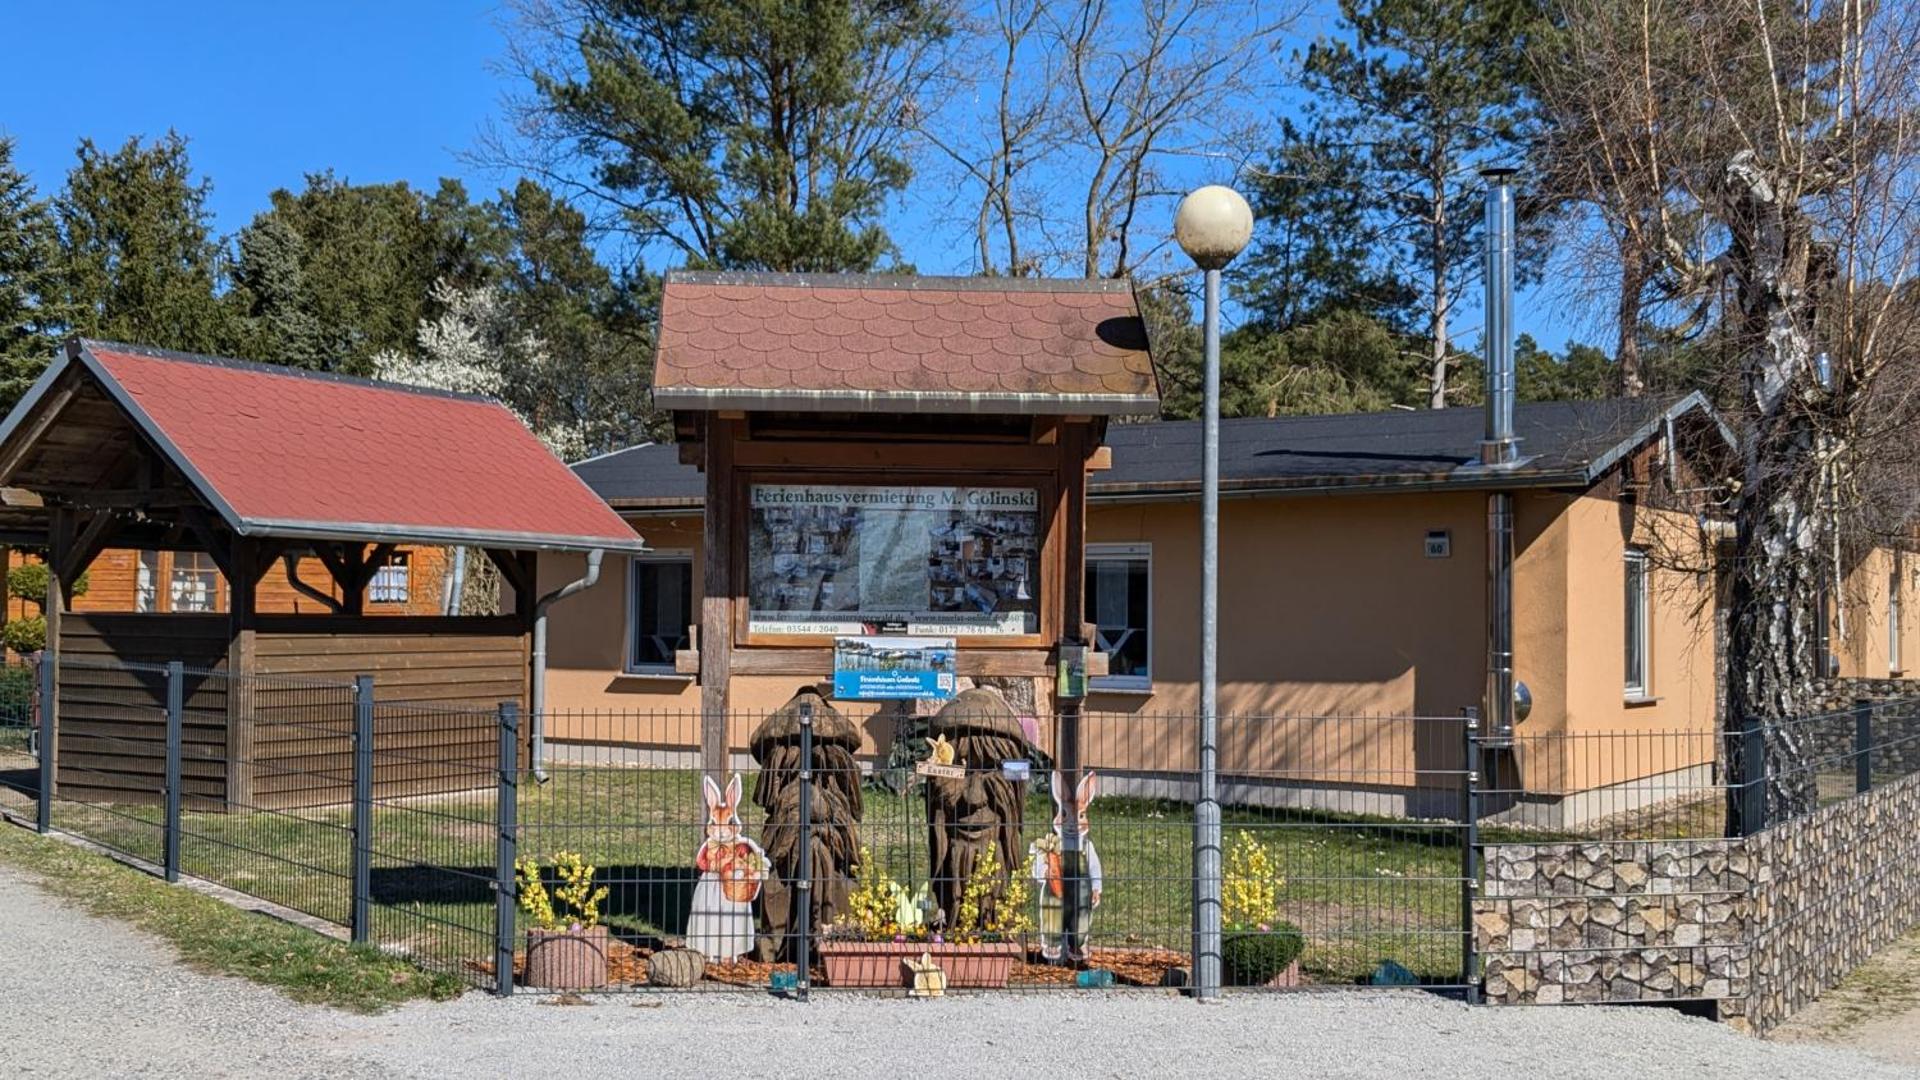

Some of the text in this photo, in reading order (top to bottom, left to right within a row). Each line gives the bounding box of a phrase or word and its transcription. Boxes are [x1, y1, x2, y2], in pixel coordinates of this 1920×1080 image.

[755, 487, 1035, 508] Ferienhausvermietung M. Golinski
